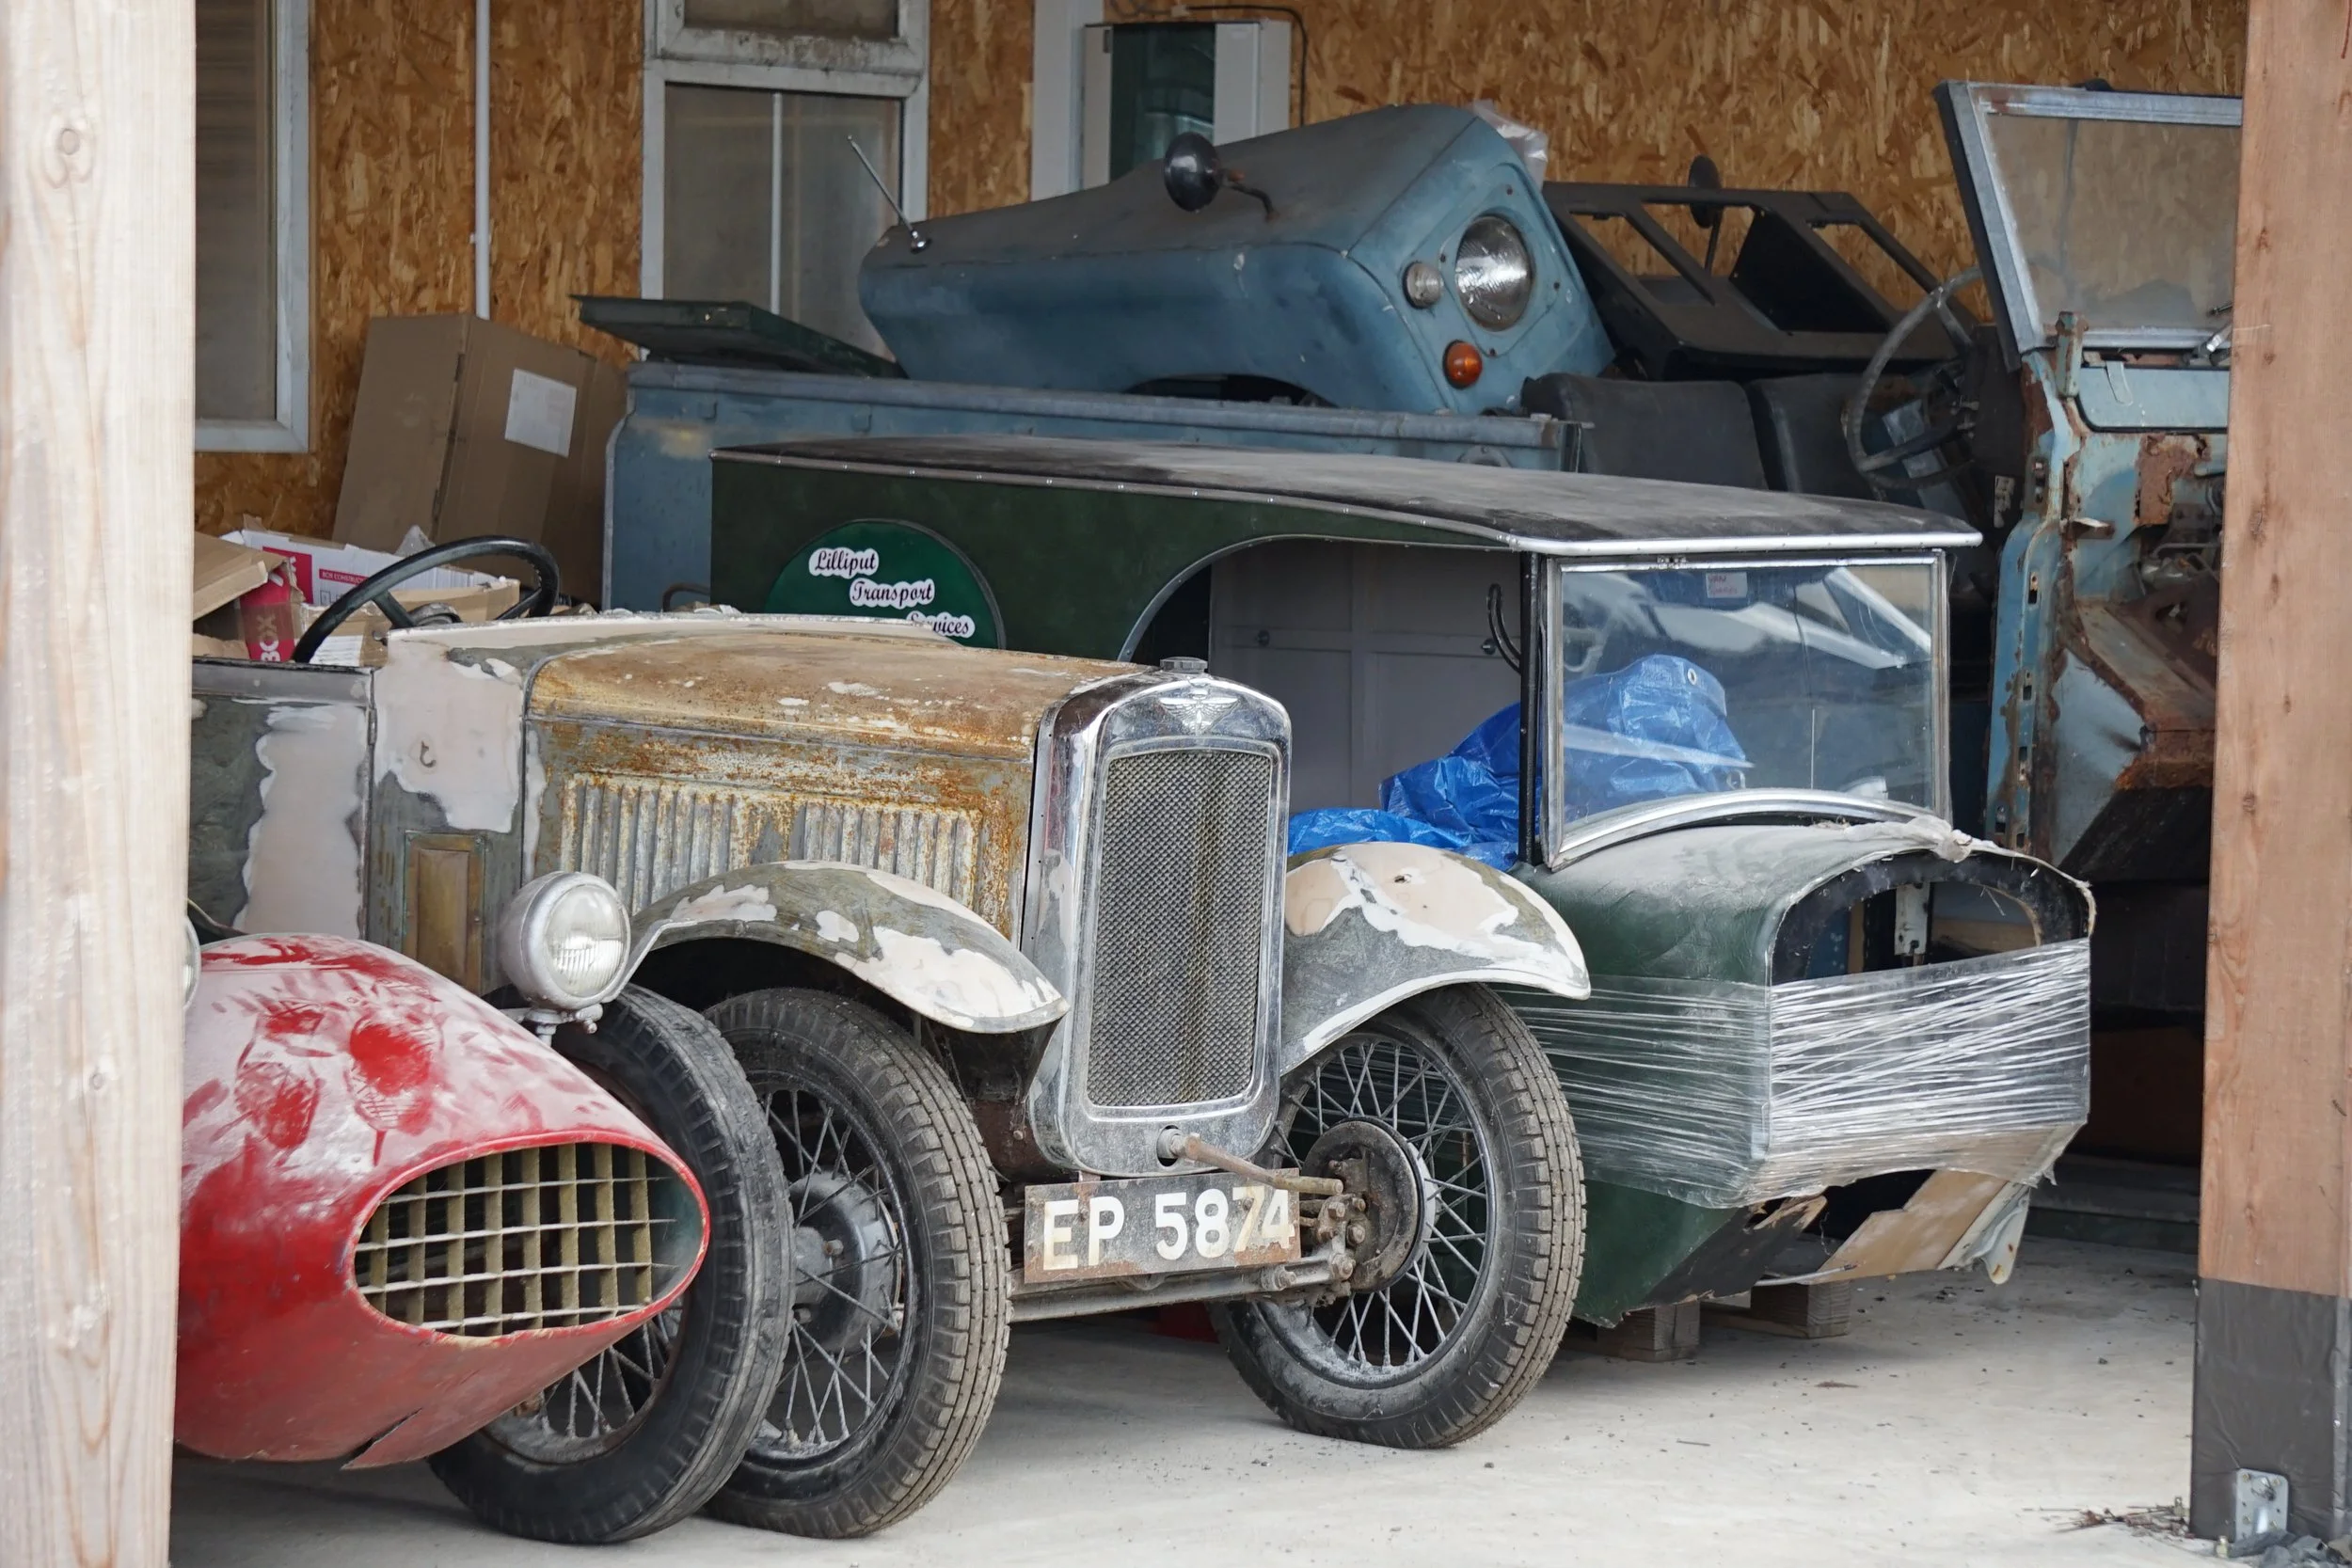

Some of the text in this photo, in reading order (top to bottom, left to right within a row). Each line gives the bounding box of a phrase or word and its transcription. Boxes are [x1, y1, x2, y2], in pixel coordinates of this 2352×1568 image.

[815, 550, 876, 577] Lilliput
[851, 579, 932, 607] Transport
[911, 612, 969, 635] Svices
[1042, 1185, 1295, 1271] EP 5874
